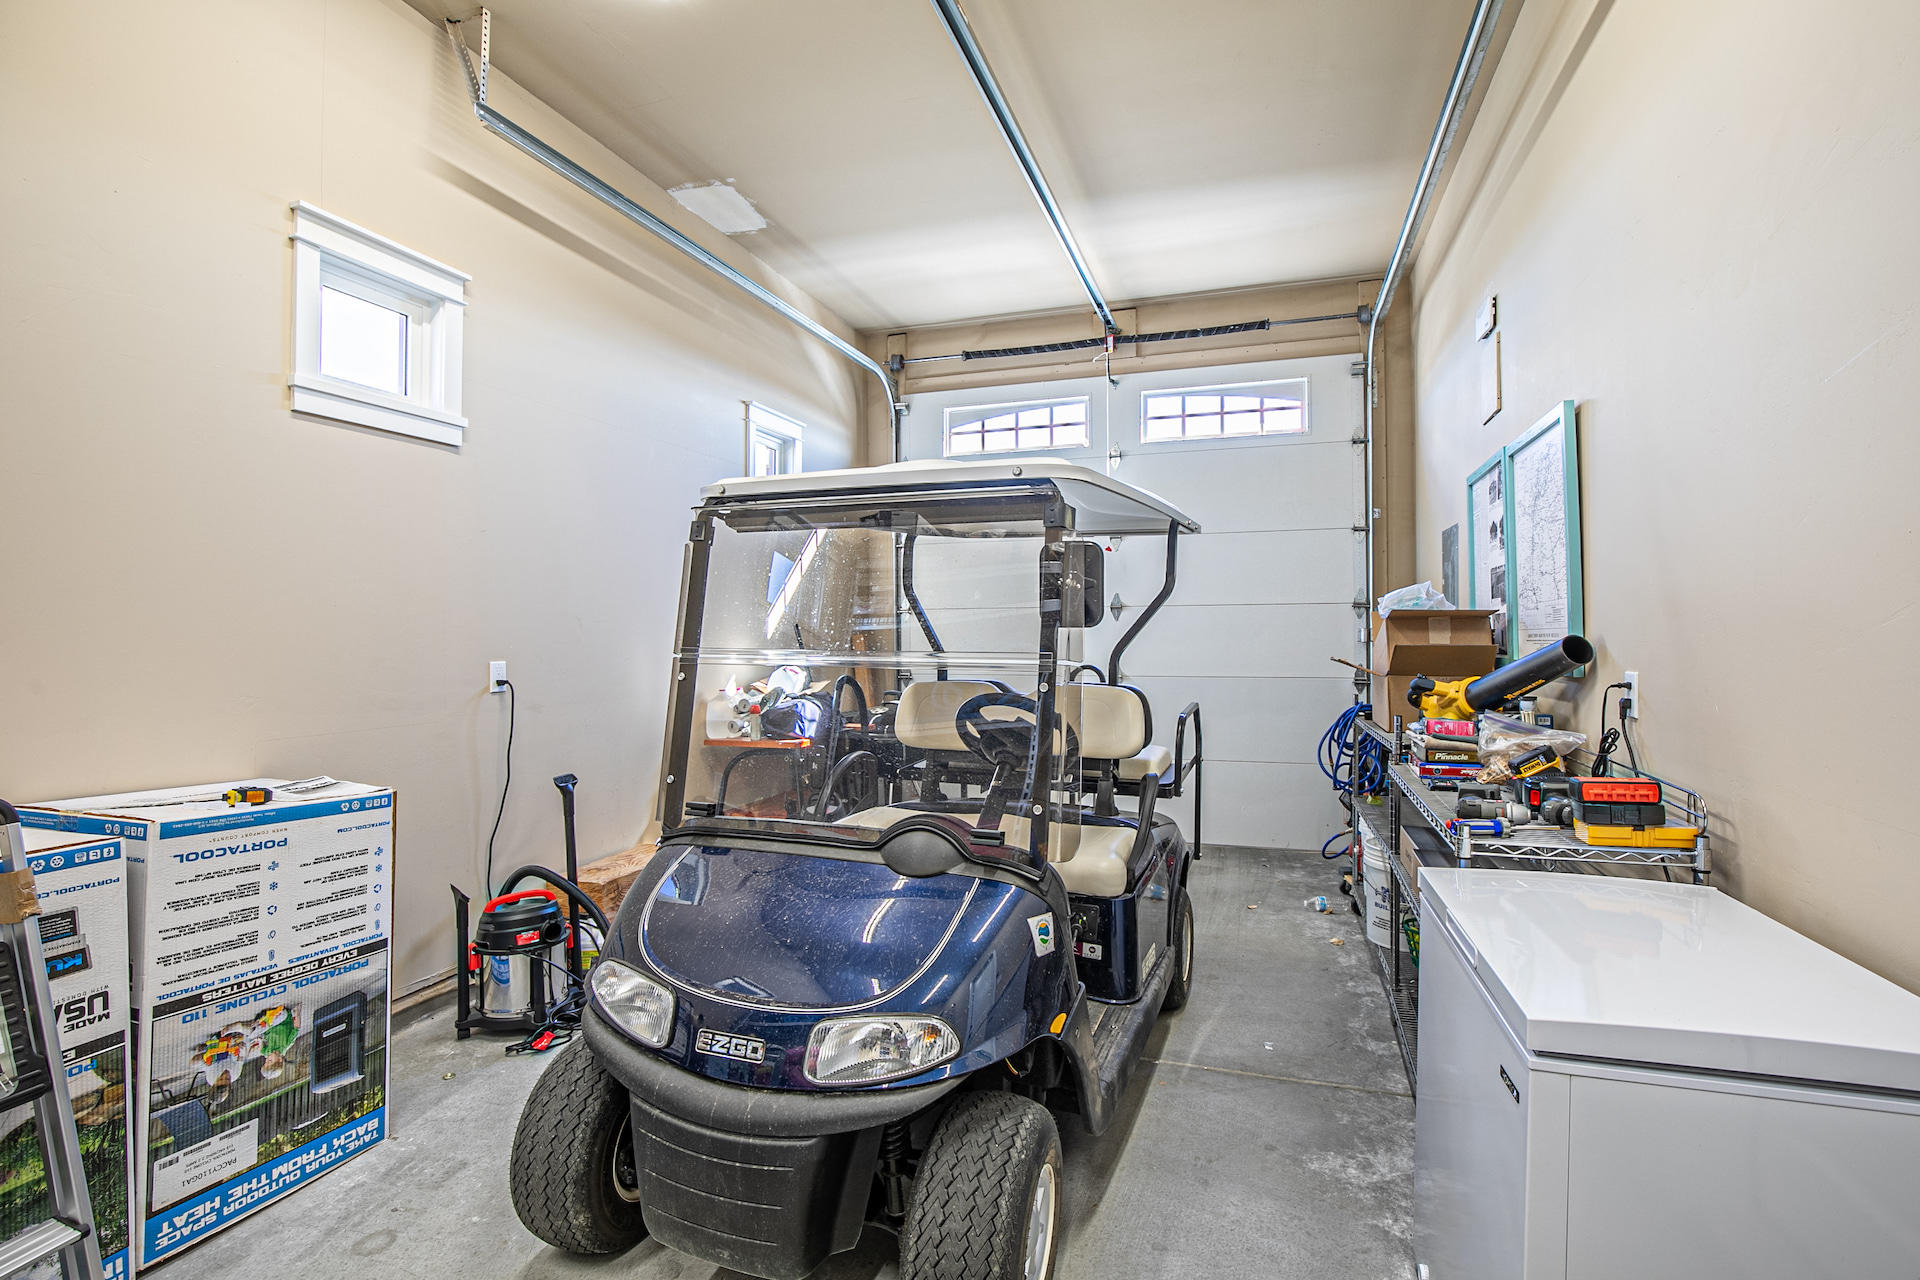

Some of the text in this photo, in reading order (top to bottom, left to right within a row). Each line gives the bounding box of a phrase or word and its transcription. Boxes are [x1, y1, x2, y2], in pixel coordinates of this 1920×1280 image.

[1435, 752, 1469, 761] Pinnacle
[337, 821, 390, 833] PORTACOOL.COM
[174, 838, 287, 863] PORTACOOL
[36, 877, 119, 901] PORTACOOL.CO
[288, 932, 382, 964] PORTACOOL ADVANTAGES
[46, 954, 82, 973] KU
[202, 949, 357, 1002] EVERY DEGREE MATTERS
[157, 964, 278, 1001] VENTAJAS DE PORTACOOL
[182, 960, 368, 1024] PORTACOOL CYCLONE 110
[52, 991, 86, 1006] DOMESTI
[64, 1009, 110, 1033] MADE
[67, 1059, 97, 1077] PO
[158, 1118, 378, 1237] BACK FROM THE HEAT
[155, 1131, 378, 1250] TAKE YOUR OUTDOOR SPACE
